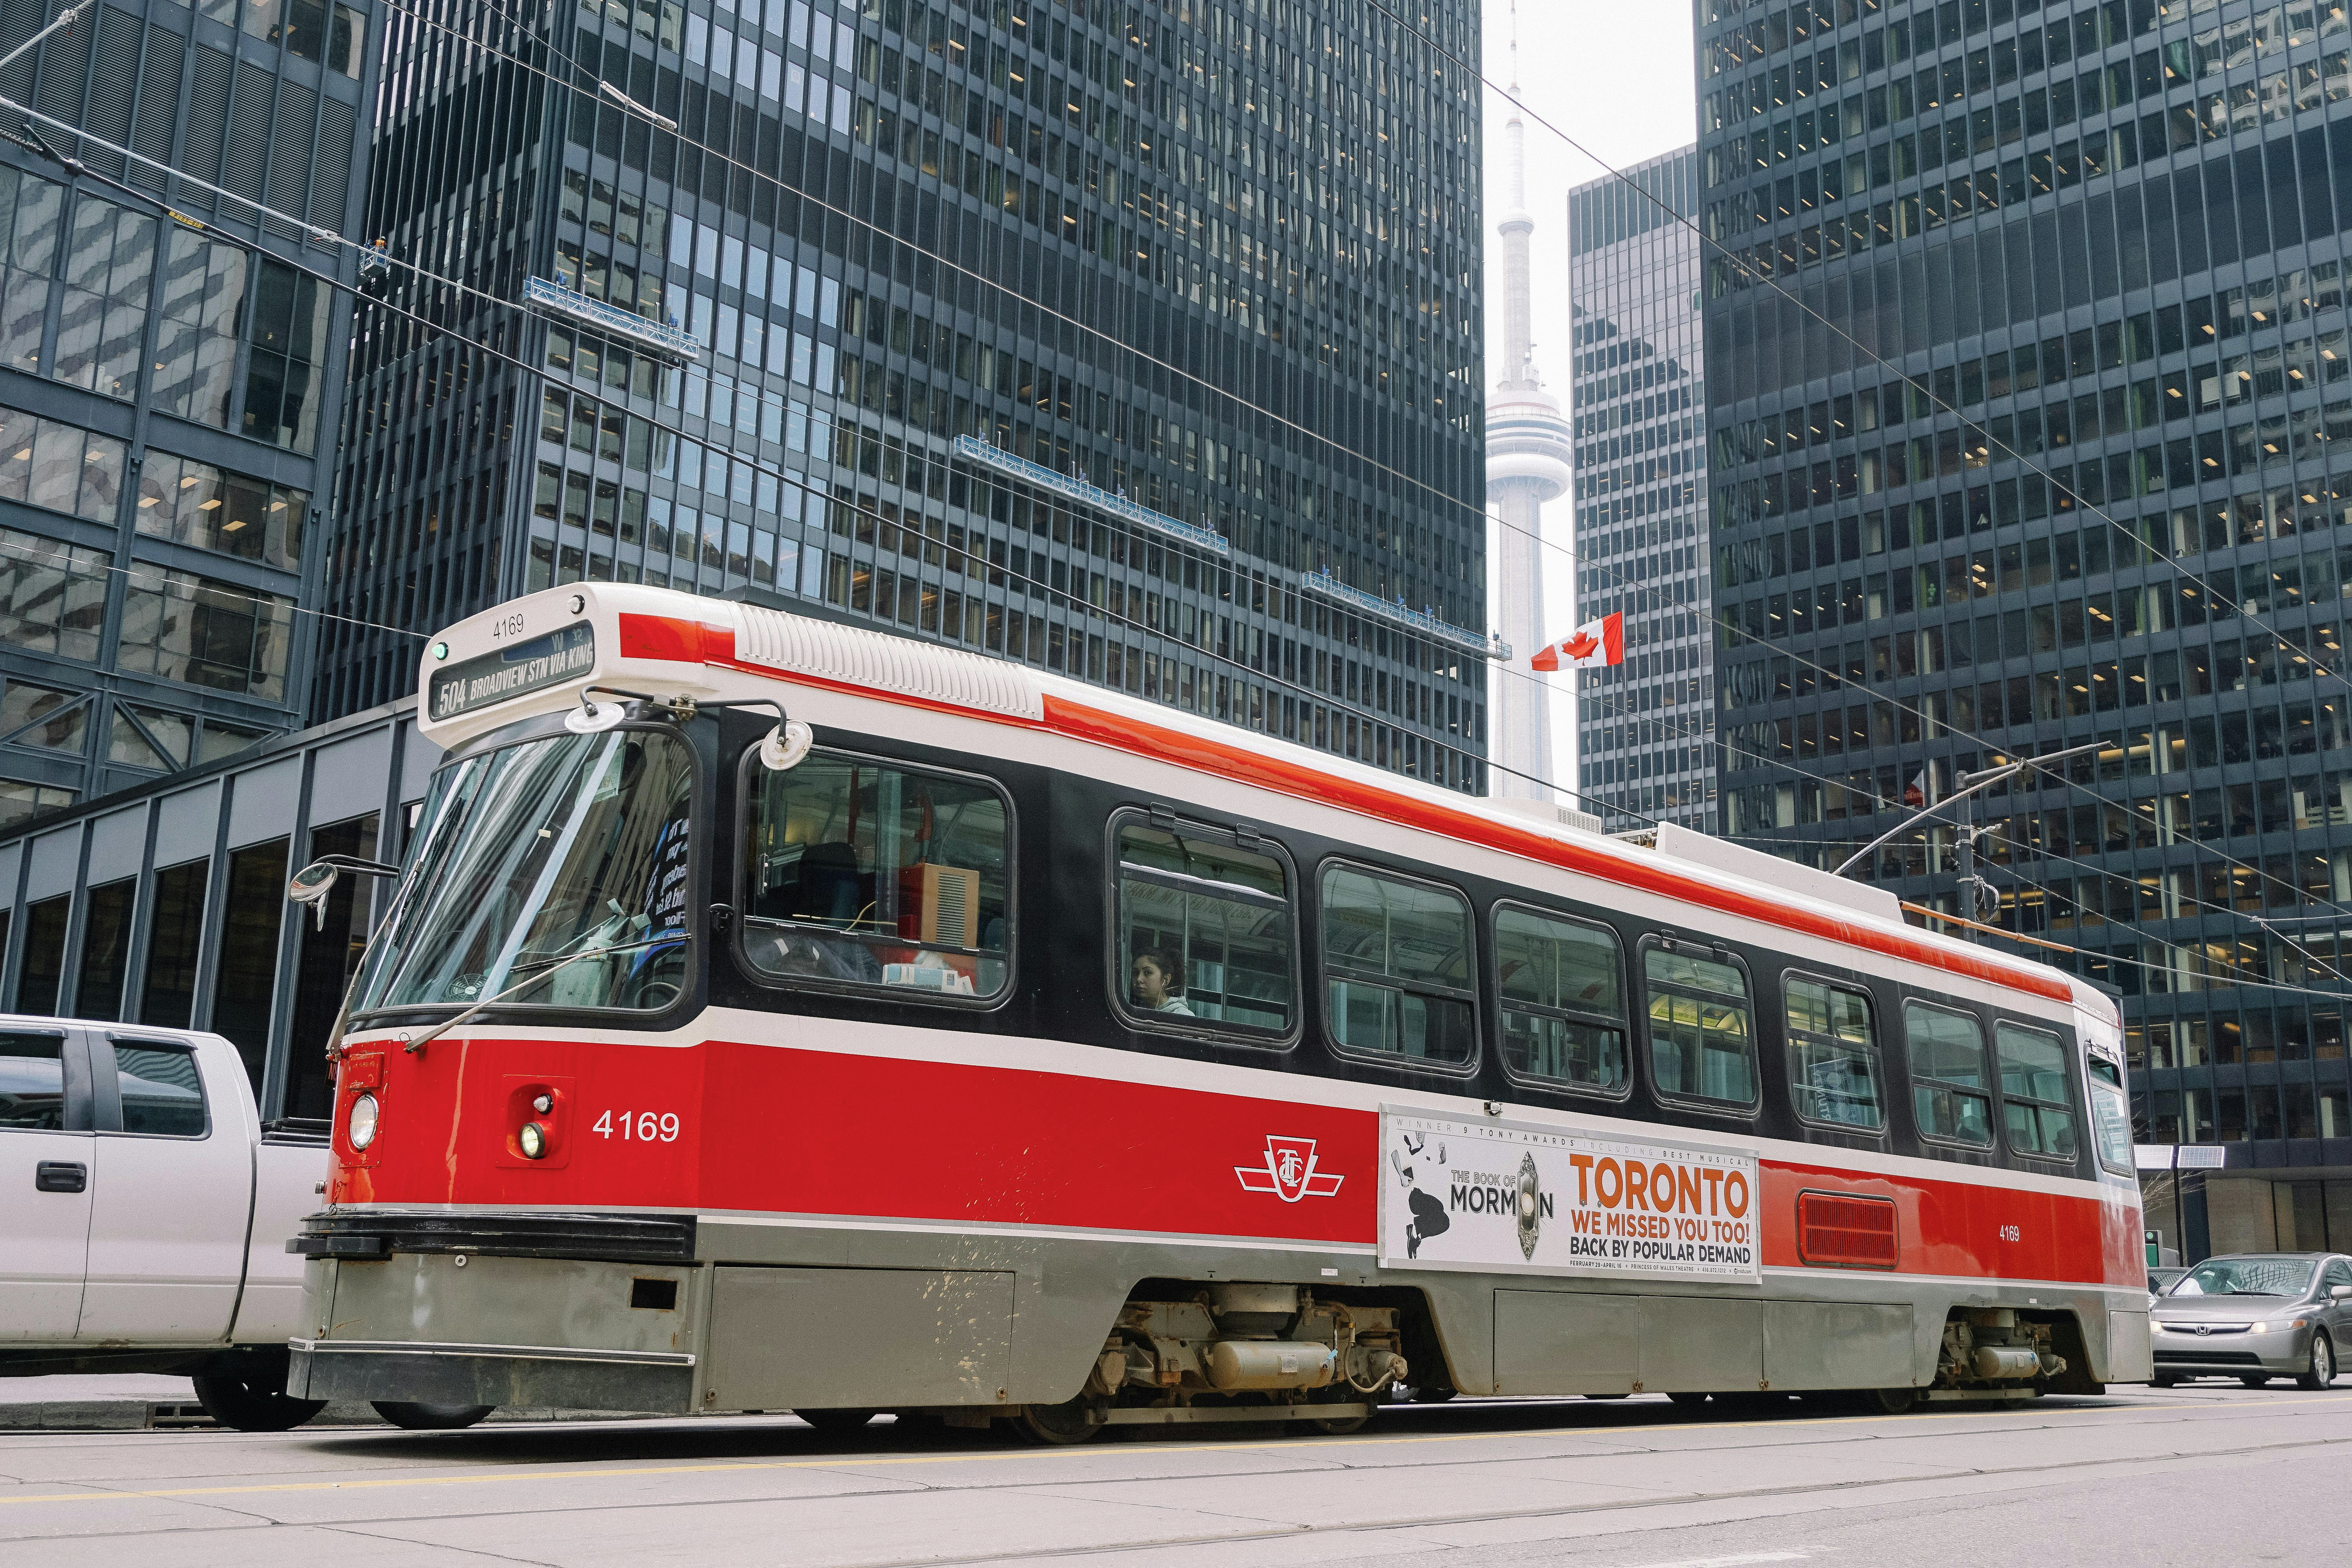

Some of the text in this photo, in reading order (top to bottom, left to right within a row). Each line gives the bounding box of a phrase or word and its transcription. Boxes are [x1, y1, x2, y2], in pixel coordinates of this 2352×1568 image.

[493, 614, 523, 639] 4169
[439, 641, 593, 720] 504 BROADVIEW STN VIA KING
[593, 1110, 680, 1143] 4169
[1397, 1117, 1451, 1132] WINNER
[1480, 1128, 1513, 1139] TONY
[1584, 1140, 1653, 1156] INCLUDING
[1663, 1150, 1690, 1160] BEST
[1700, 1154, 1749, 1167] MUSICAL
[1451, 1170, 1516, 1187] THE BOOK OF
[1570, 1154, 1749, 1219] TORONTO,
[1571, 1209, 1750, 1244] WE MISSED YOU TOO!
[1999, 1224, 2020, 1242] 4169
[1570, 1236, 1751, 1264] BACK BY POPULAR DEMAND
